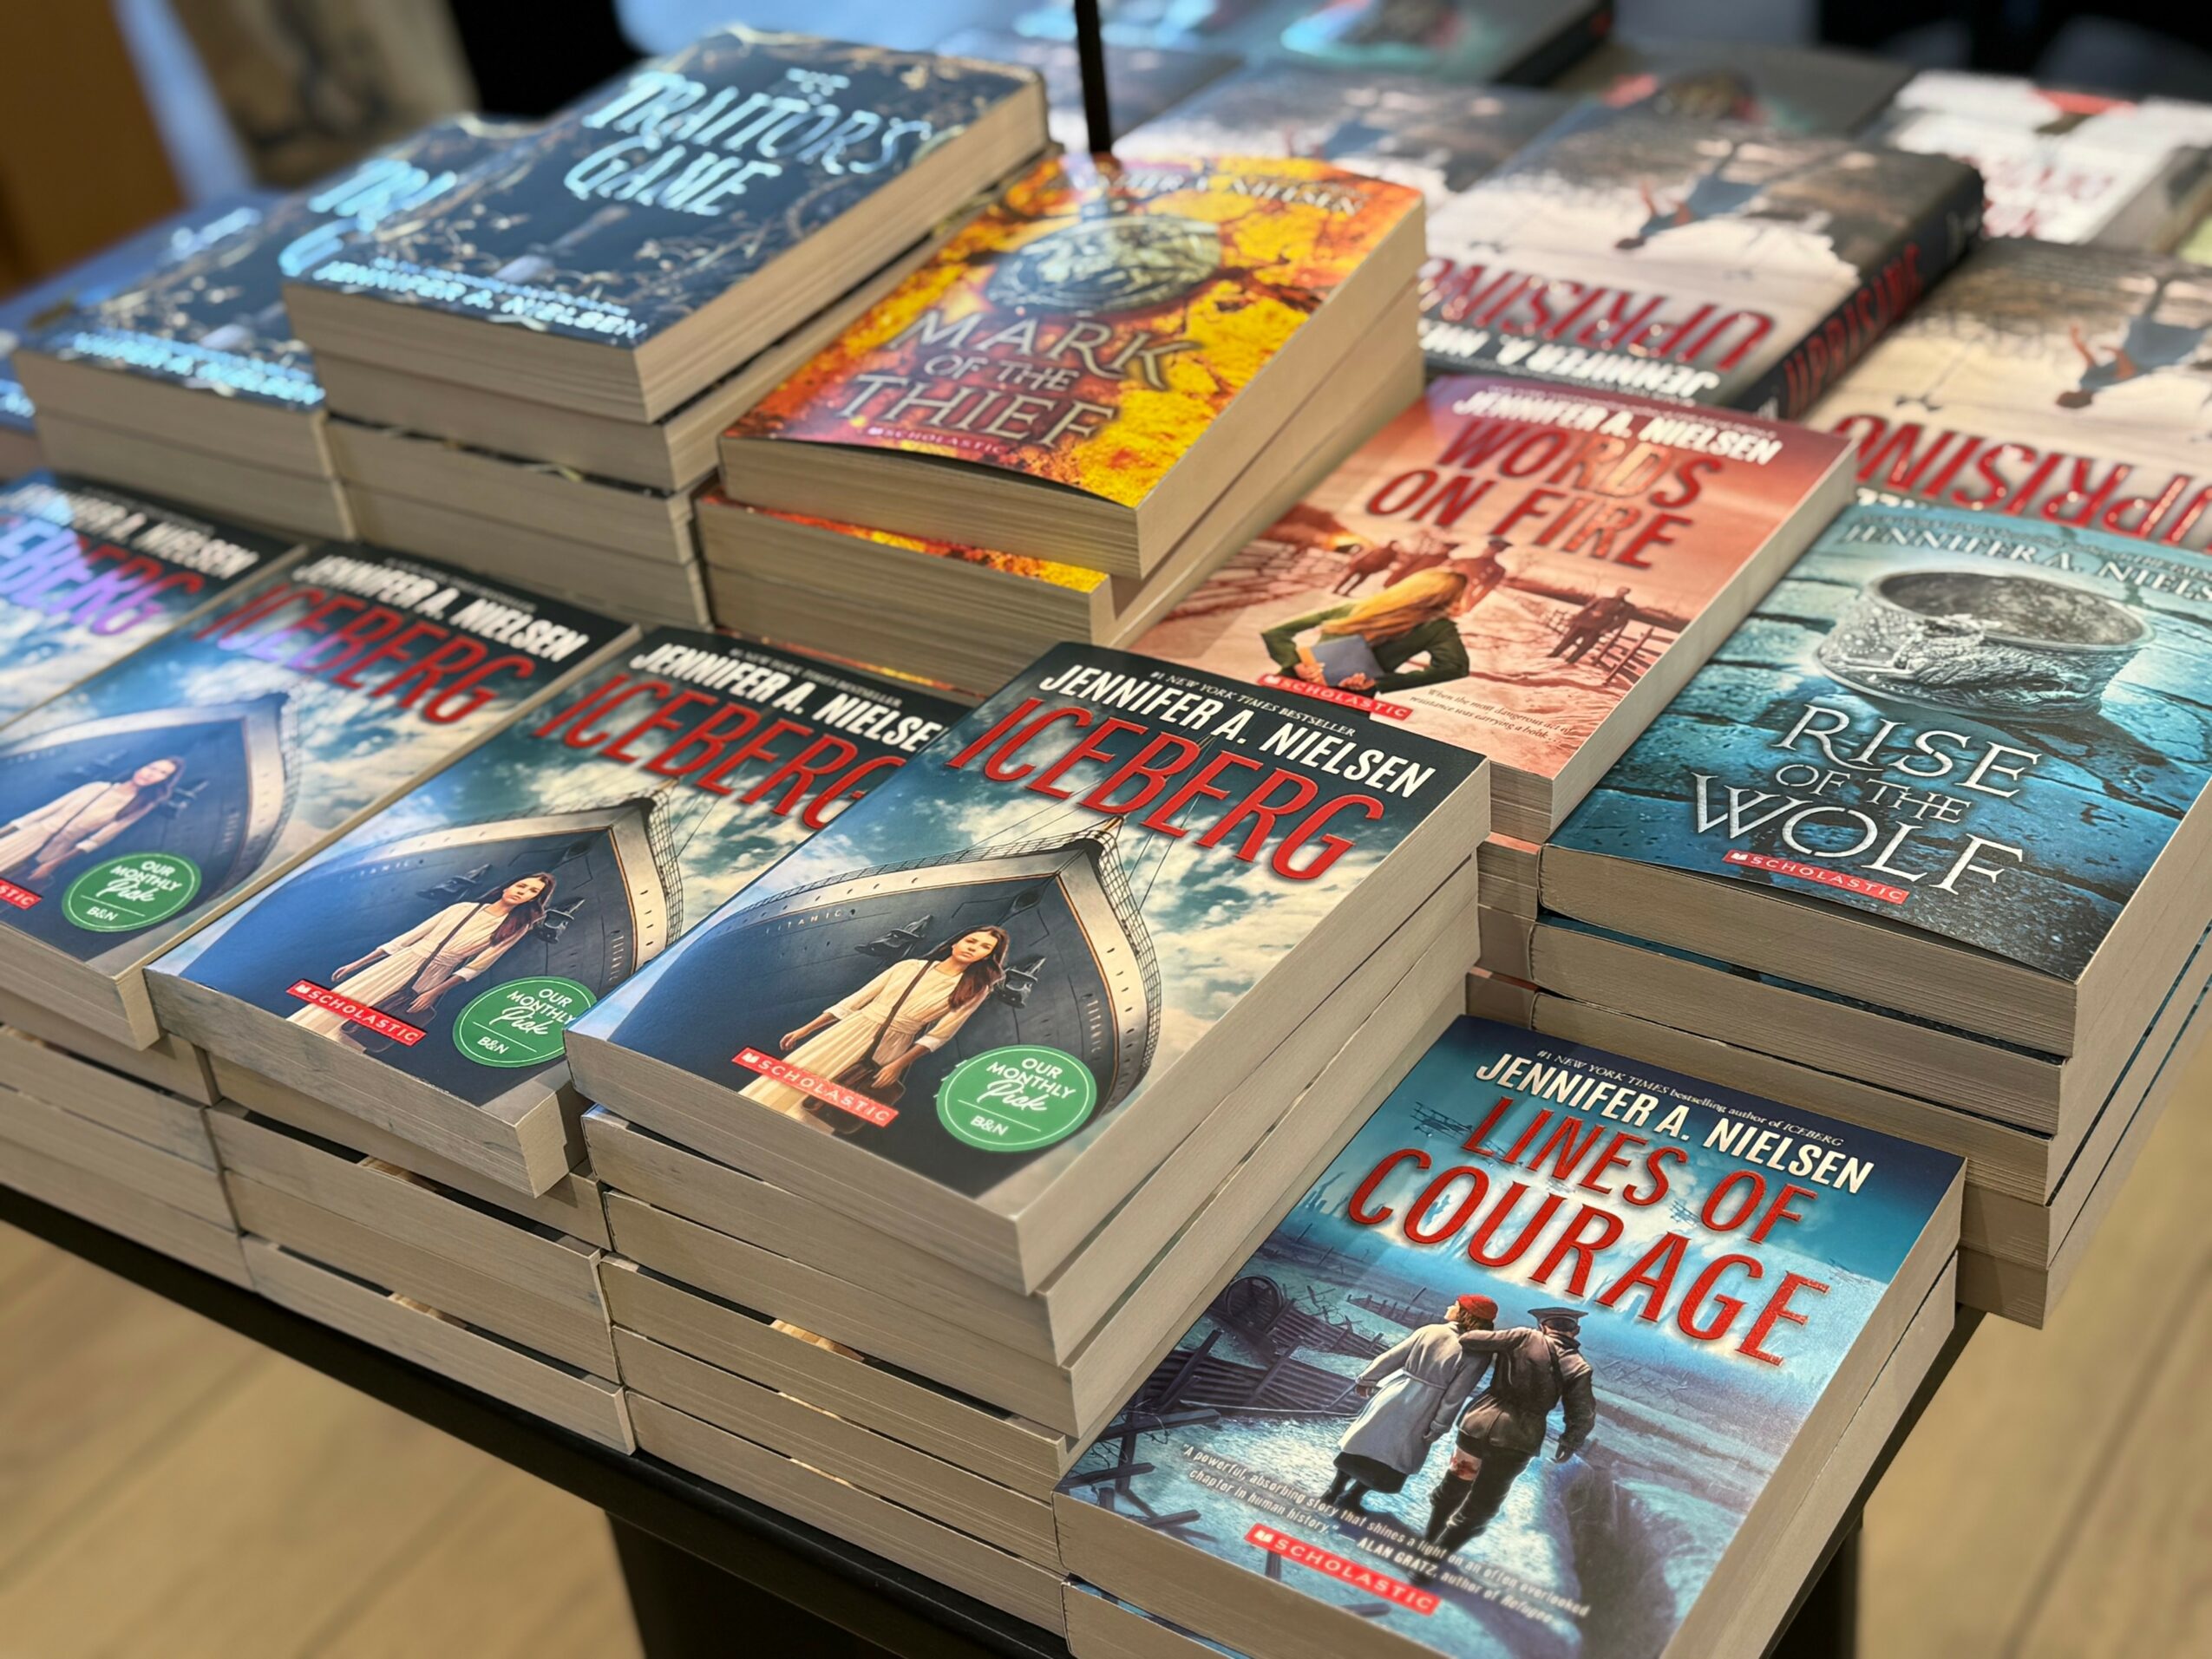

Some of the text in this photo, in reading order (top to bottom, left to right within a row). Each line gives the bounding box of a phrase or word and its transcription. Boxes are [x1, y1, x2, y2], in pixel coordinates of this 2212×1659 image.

[564, 135, 782, 216] GAME
[890, 310, 1196, 390] MARK
[924, 355, 1080, 391] OF THE
[1527, 343, 1719, 398] JENNIFER
[839, 373, 1116, 449] THIEF
[1453, 391, 1609, 431] JENNIFER
[1600, 410, 1635, 438] A.
[1639, 416, 1783, 465] NIELSEN
[883, 431, 1002, 454] SCHOLASTIC
[1436, 419, 1722, 509] WORDS
[1366, 470, 1693, 569] ON FIRE
[1842, 525, 2039, 563] JENNIFER
[292, 555, 438, 607] JENNIFER
[449, 598, 590, 663] NIELSEN
[192, 583, 535, 724] ICEBERG
[629, 643, 949, 753] JENNIFER A. NIELSE
[1150, 671, 1356, 737] #1 NEW YORK TIMES BESTSELLER
[1281, 678, 1408, 717] SCHOLASTIC
[1410, 696, 1454, 712] resistance
[1456, 708, 1473, 717] was
[1476, 715, 1515, 730] carrying
[1428, 689, 1453, 702] When
[1455, 695, 1469, 705] the
[1495, 707, 1543, 726] dangerous
[1544, 722, 1560, 731] act
[1040, 664, 1436, 798] JENNIFER A. NIELSEN
[1771, 703, 2042, 798] RISE
[945, 698, 1385, 879] ICEBERG
[1775, 764, 1972, 824] OF THE
[1691, 772, 2023, 895] WOLF
[96, 878, 159, 902] Pick
[109, 865, 182, 892] MONTHLY
[141, 860, 175, 875] OUR
[1751, 855, 1904, 902] SCHOLASTIC
[86, 907, 118, 921] B&N
[308, 990, 420, 1042] SCHOLASTIC
[489, 1007, 549, 1035] Pick
[507, 990, 577, 1024] MONTHLY
[539, 988, 573, 1008] OUR
[476, 1036, 510, 1054] B&N
[1022, 1058, 1063, 1078] OUR
[757, 1059, 891, 1123] SCHOLASTIC
[977, 1079, 1047, 1112] Pick
[986, 1062, 1076, 1100] MONTHLY
[1537, 1050, 1844, 1146] #1 NEW YORK TIMES bestselling author of ICEBERG
[970, 1114, 1009, 1136] B&N
[1475, 1053, 1875, 1194] JENNIFER A. NIELSEN
[1460, 1095, 1819, 1244] LINES OF
[1347, 1146, 1831, 1367] COURAGE
[1189, 1469, 1233, 1493] chapter
[1236, 1487, 1247, 1499] in
[1247, 1493, 1286, 1514] human
[1357, 1537, 1394, 1559] ALAN
[1394, 1552, 1438, 1578] GRATZ,
[1440, 1571, 1482, 1594] author
[1483, 1589, 1499, 1601] of
[1194, 1451, 1247, 1481] powerful,
[1249, 1474, 1307, 1504] absorbing
[1307, 1498, 1339, 1517] story
[1340, 1509, 1367, 1527] that
[1367, 1519, 1405, 1544] shines
[1407, 1538, 1414, 1546] a
[1417, 1539, 1448, 1559] light
[1447, 1552, 1463, 1566] on
[1465, 1560, 1482, 1574] an
[1483, 1564, 1518, 1589] often
[1520, 1580, 1591, 1617] overlooked
[1274, 1538, 1434, 1610] SCHOLASTIC
